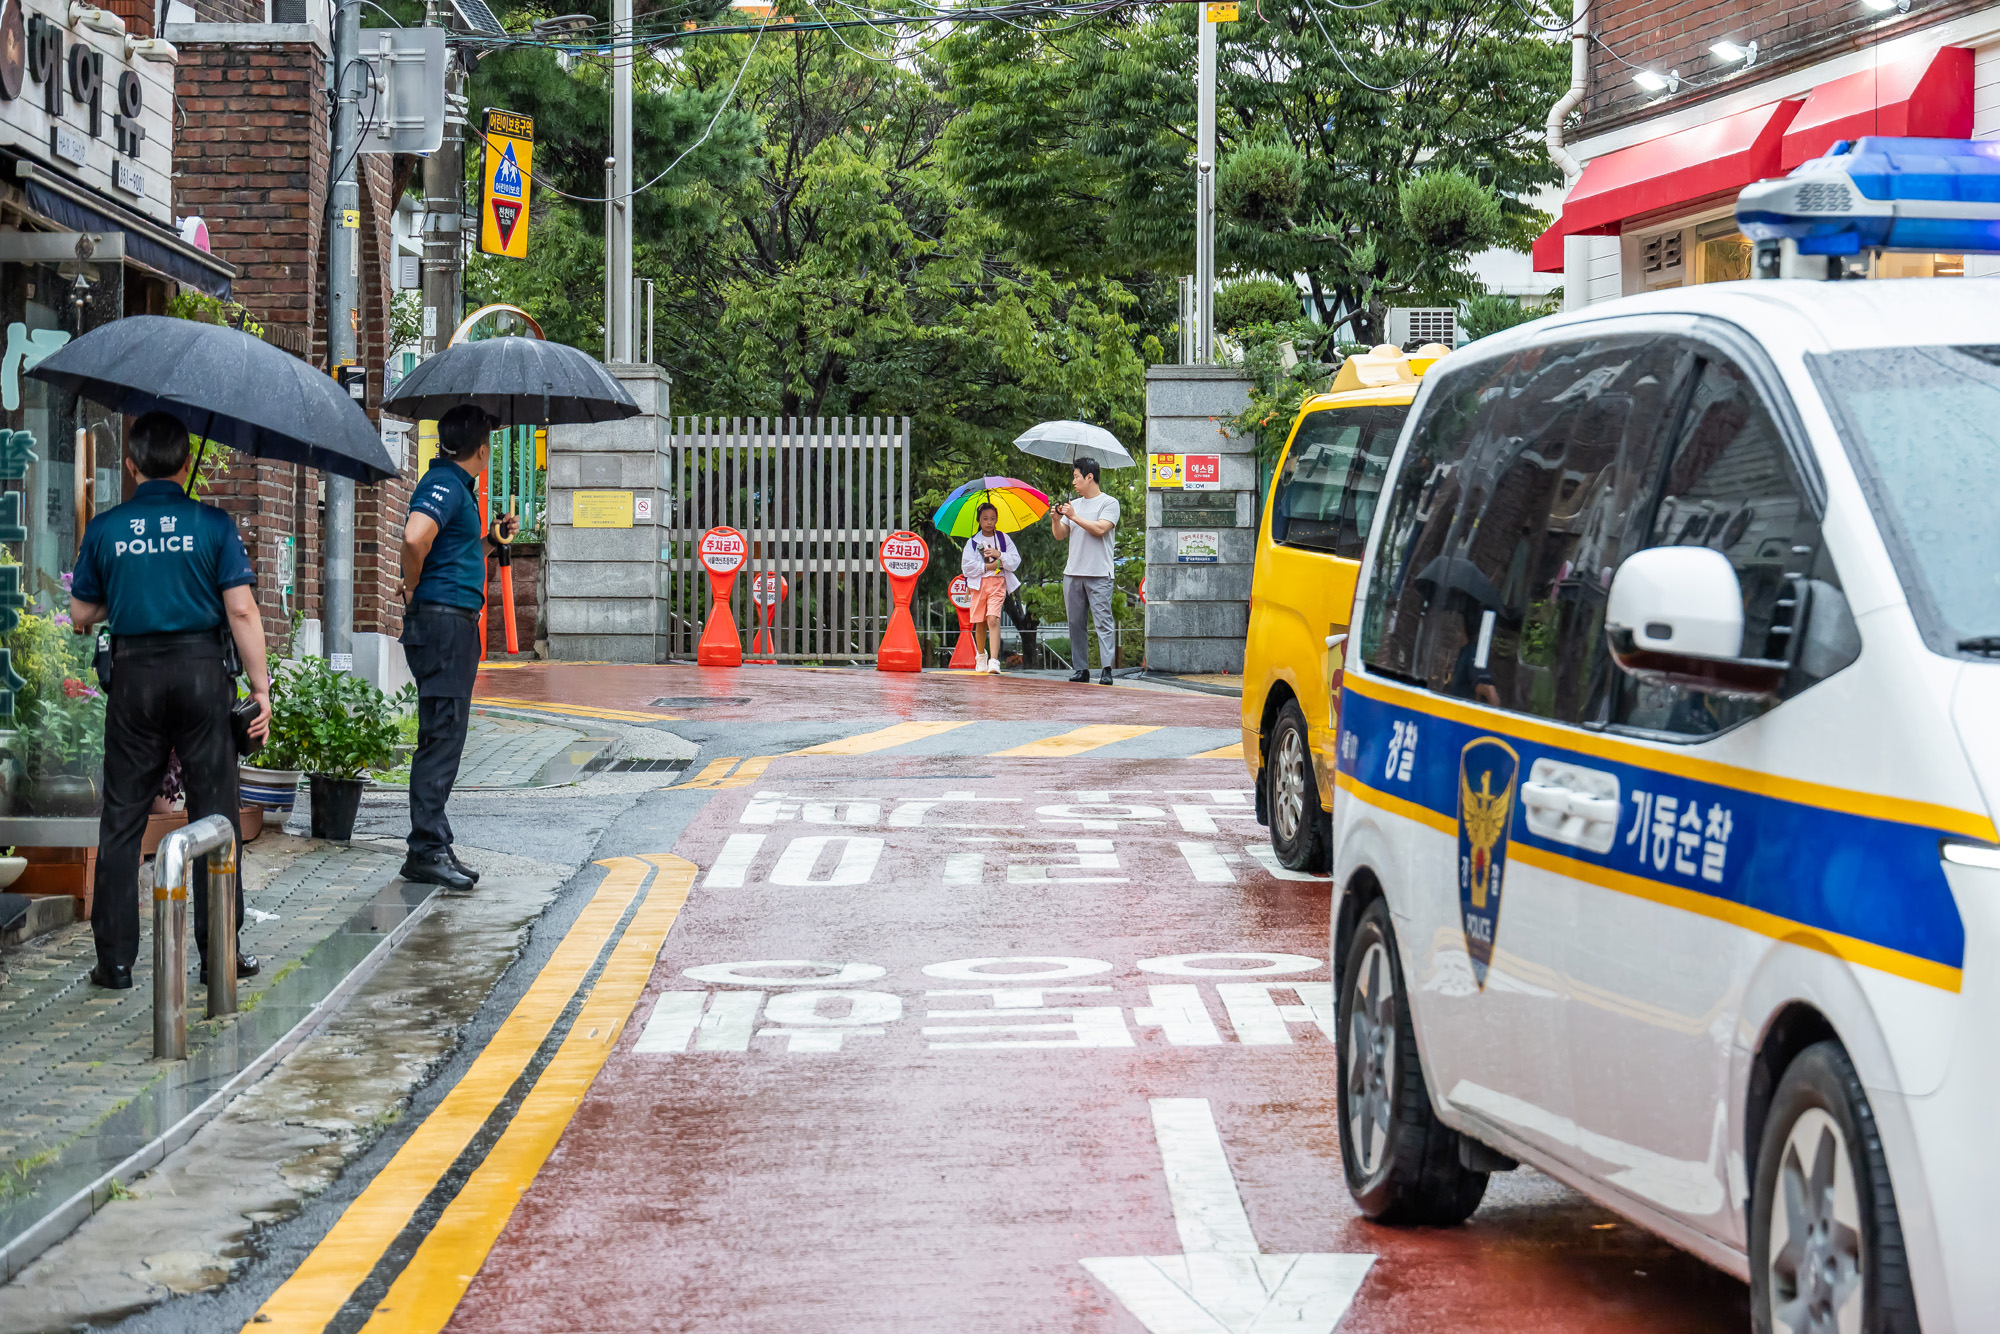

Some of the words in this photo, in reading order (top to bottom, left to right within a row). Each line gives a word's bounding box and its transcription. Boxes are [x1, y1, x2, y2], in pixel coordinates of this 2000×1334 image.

[490, 113, 532, 137] 어린이보호구역
[495, 182, 521, 195] 어린이보호
[498, 207, 515, 219] 천천히
[1191, 464, 1214, 473] 에스원
[115, 536, 194, 557] POLICE
[706, 540, 740, 551] 주차금지
[887, 544, 920, 556] 주차금지
[1385, 720, 1418, 782] 경찰
[1626, 789, 1732, 883] 기동순찰
[1466, 913, 1491, 942] POLICE
